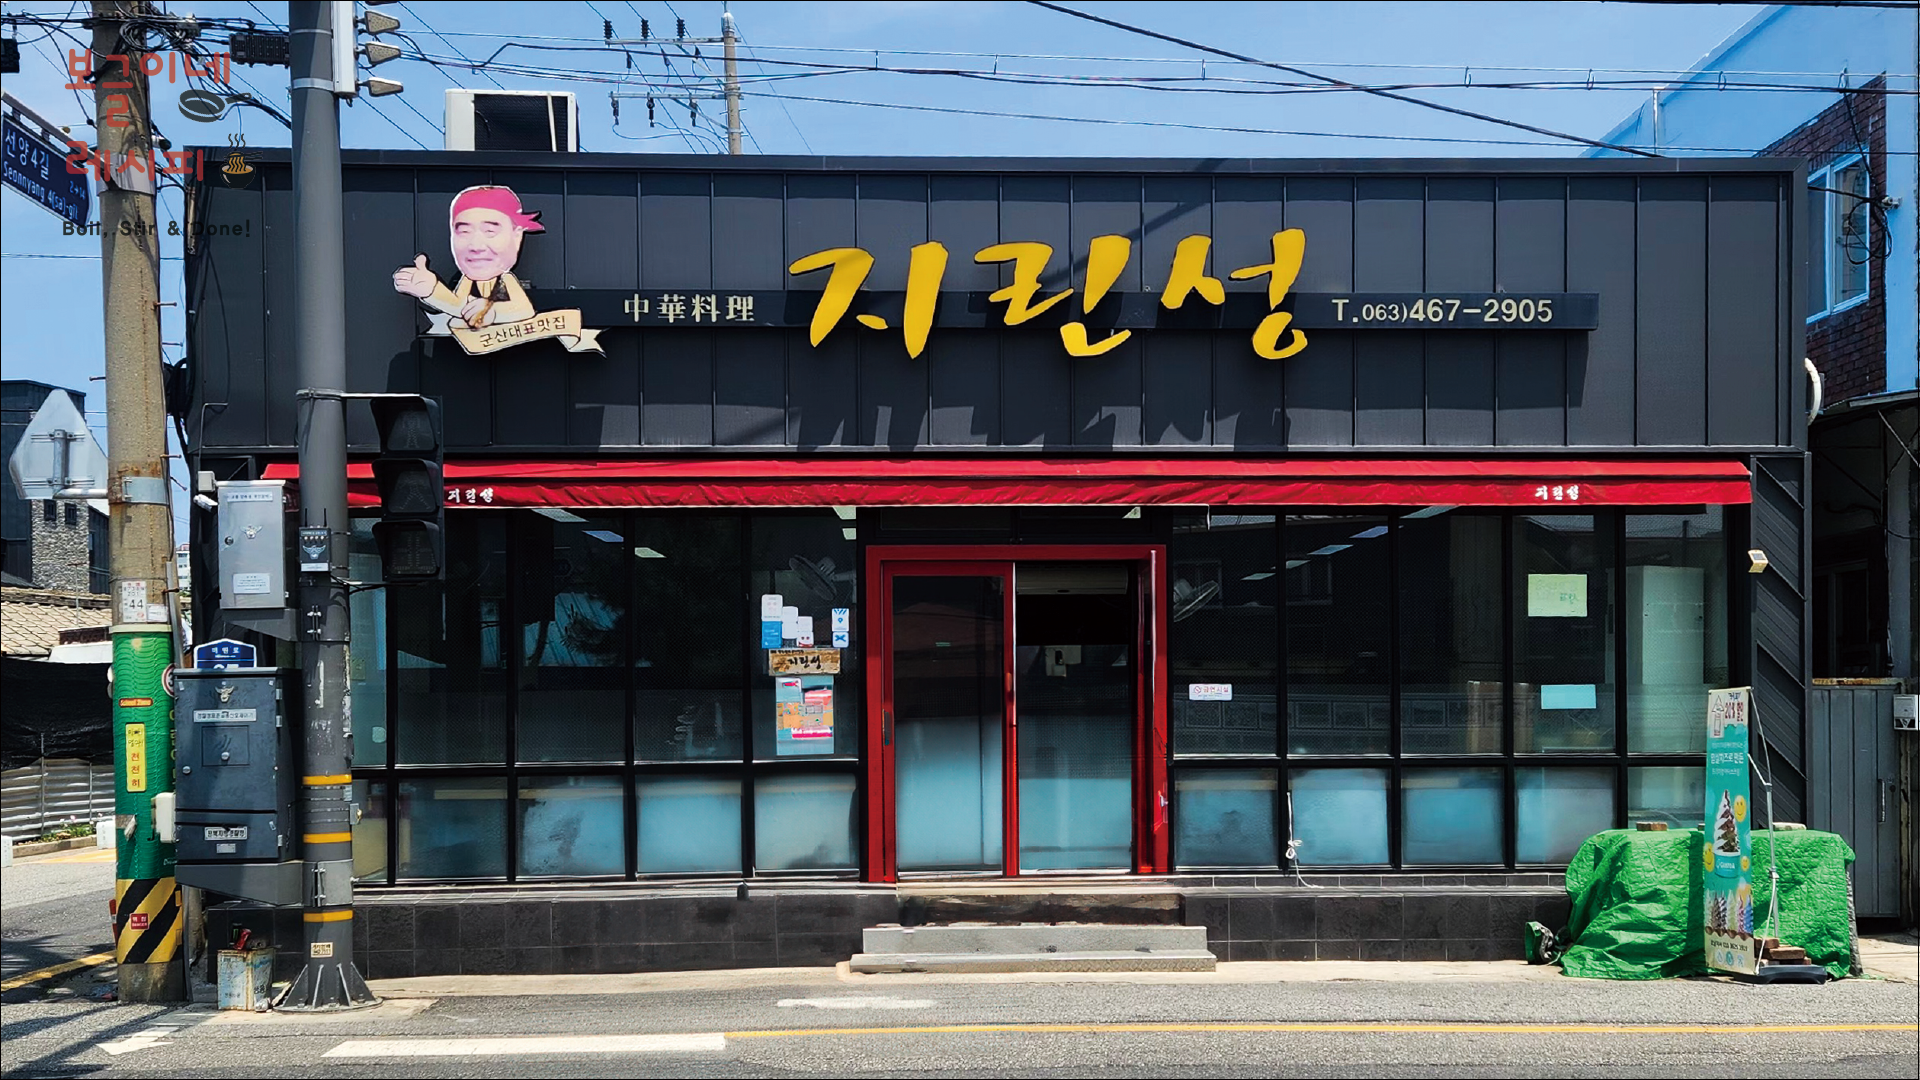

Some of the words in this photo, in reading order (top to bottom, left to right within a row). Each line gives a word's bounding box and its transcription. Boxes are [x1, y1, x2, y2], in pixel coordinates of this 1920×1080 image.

[5, 129, 49, 180] 선양4길
[3, 161, 45, 203] Seonnyang
[623, 292, 756, 324] 中華料理
[788, 227, 1307, 360] 지린성
[478, 316, 567, 349] 군산대표맛집
[129, 599, 144, 610] 44
[787, 654, 822, 670] 지린성
